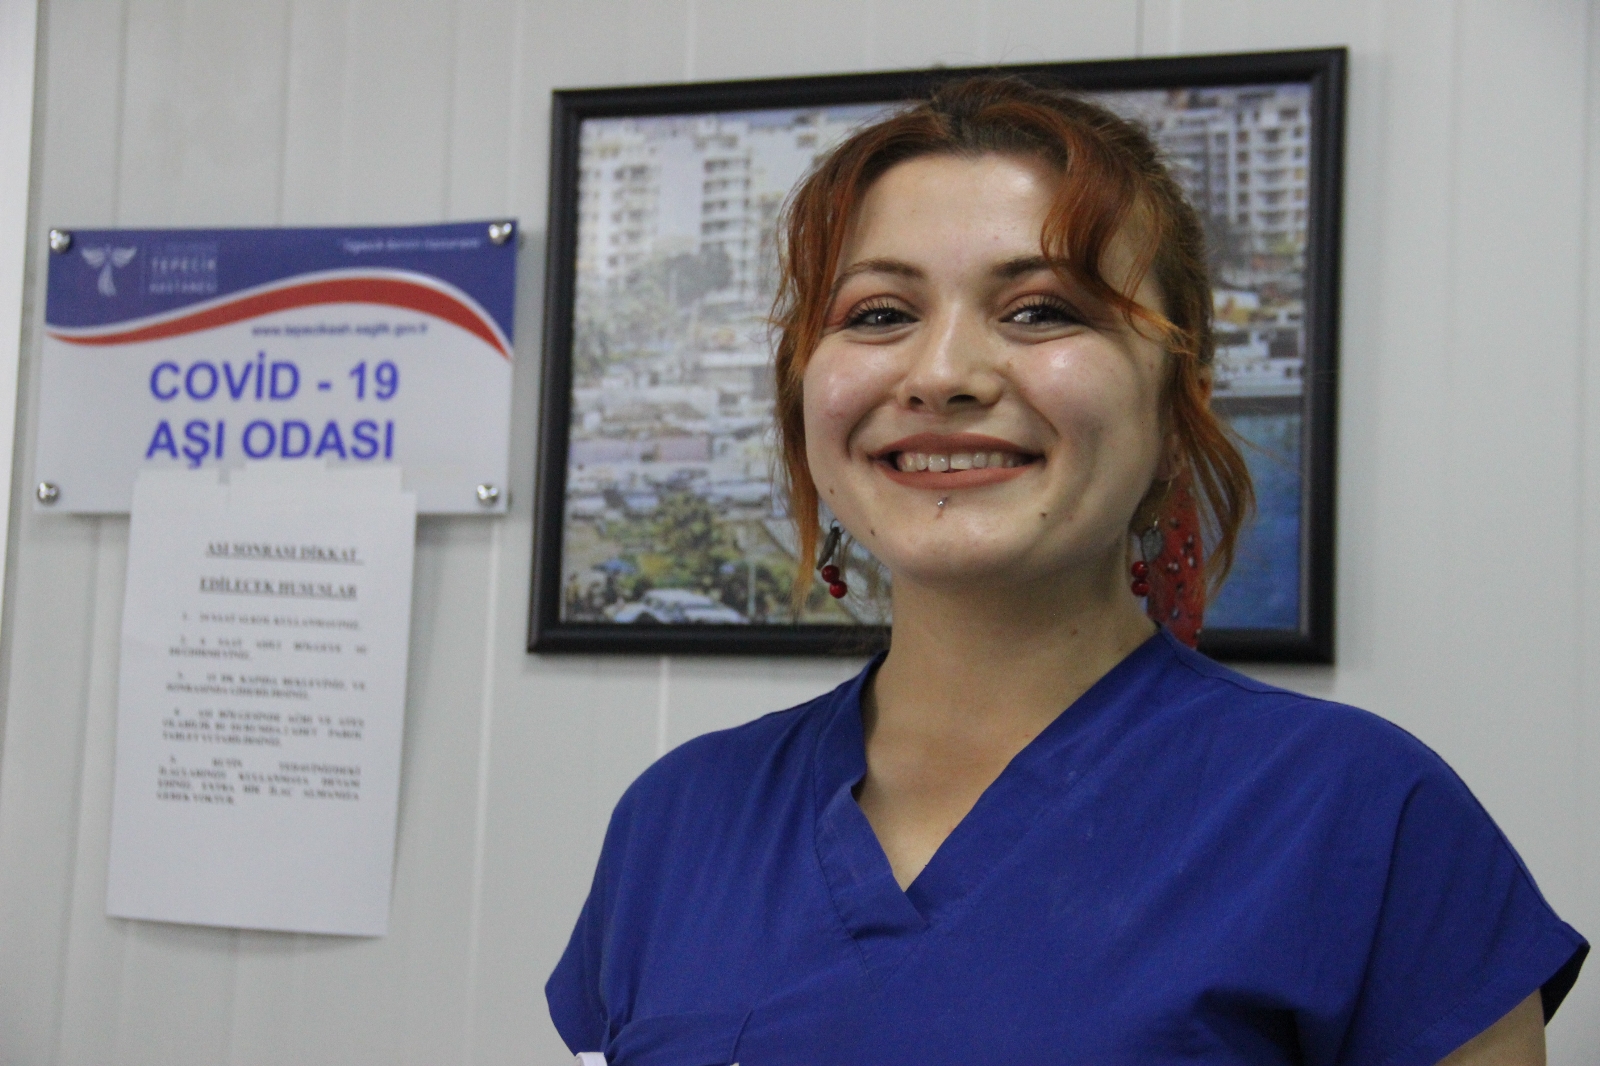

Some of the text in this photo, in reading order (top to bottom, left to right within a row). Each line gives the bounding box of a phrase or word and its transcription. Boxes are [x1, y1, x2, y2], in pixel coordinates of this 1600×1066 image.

[149, 352, 301, 400] COVİD
[349, 361, 399, 400] 19
[145, 419, 395, 469] AŞI ODASI
